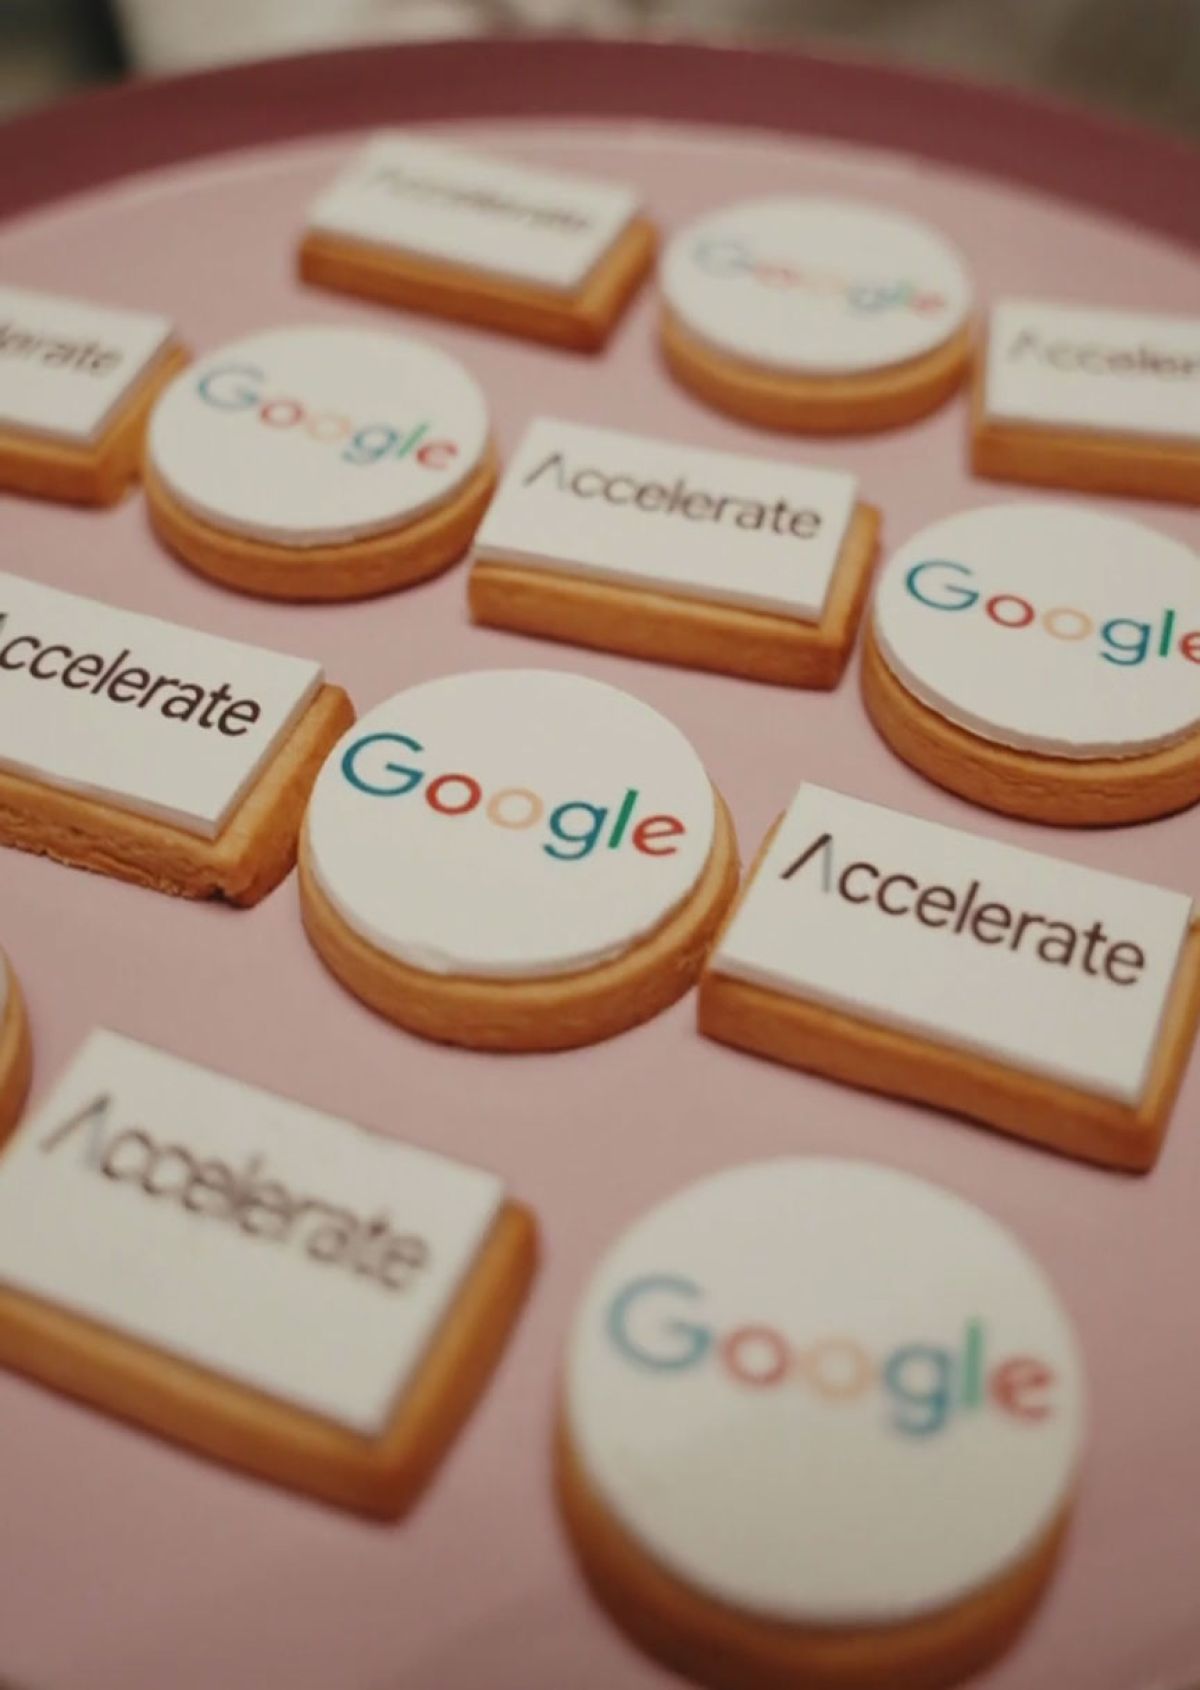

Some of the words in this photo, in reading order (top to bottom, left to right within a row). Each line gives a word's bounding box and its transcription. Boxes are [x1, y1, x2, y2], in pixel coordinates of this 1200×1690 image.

[197, 363, 459, 470] Google
[522, 453, 822, 540] Accelerate
[0, 612, 261, 737] ccelerate
[341, 732, 686, 861] Google
[781, 833, 1146, 986] Accelerate
[40, 1095, 431, 1292] Accelerate
[606, 1274, 1056, 1438] Google
